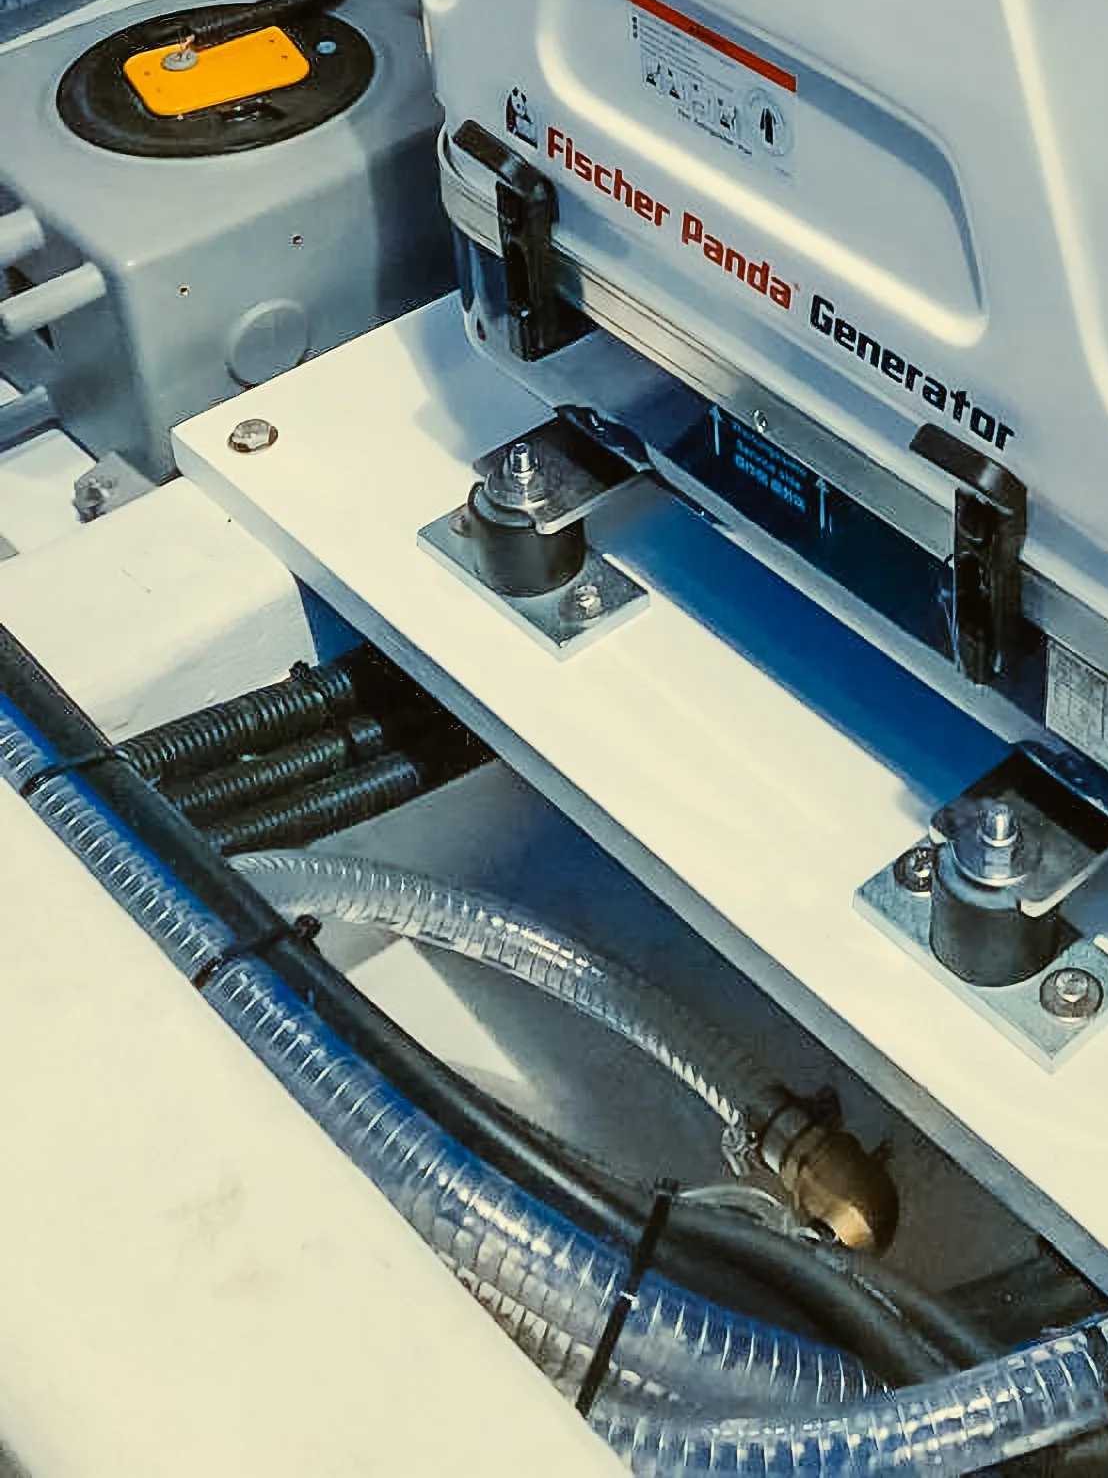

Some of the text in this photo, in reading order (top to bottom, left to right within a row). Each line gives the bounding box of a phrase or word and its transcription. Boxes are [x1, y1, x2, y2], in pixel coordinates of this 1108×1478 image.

[546, 126, 671, 227] Fischer
[681, 210, 794, 311] Panda
[808, 294, 1016, 452] Generator
